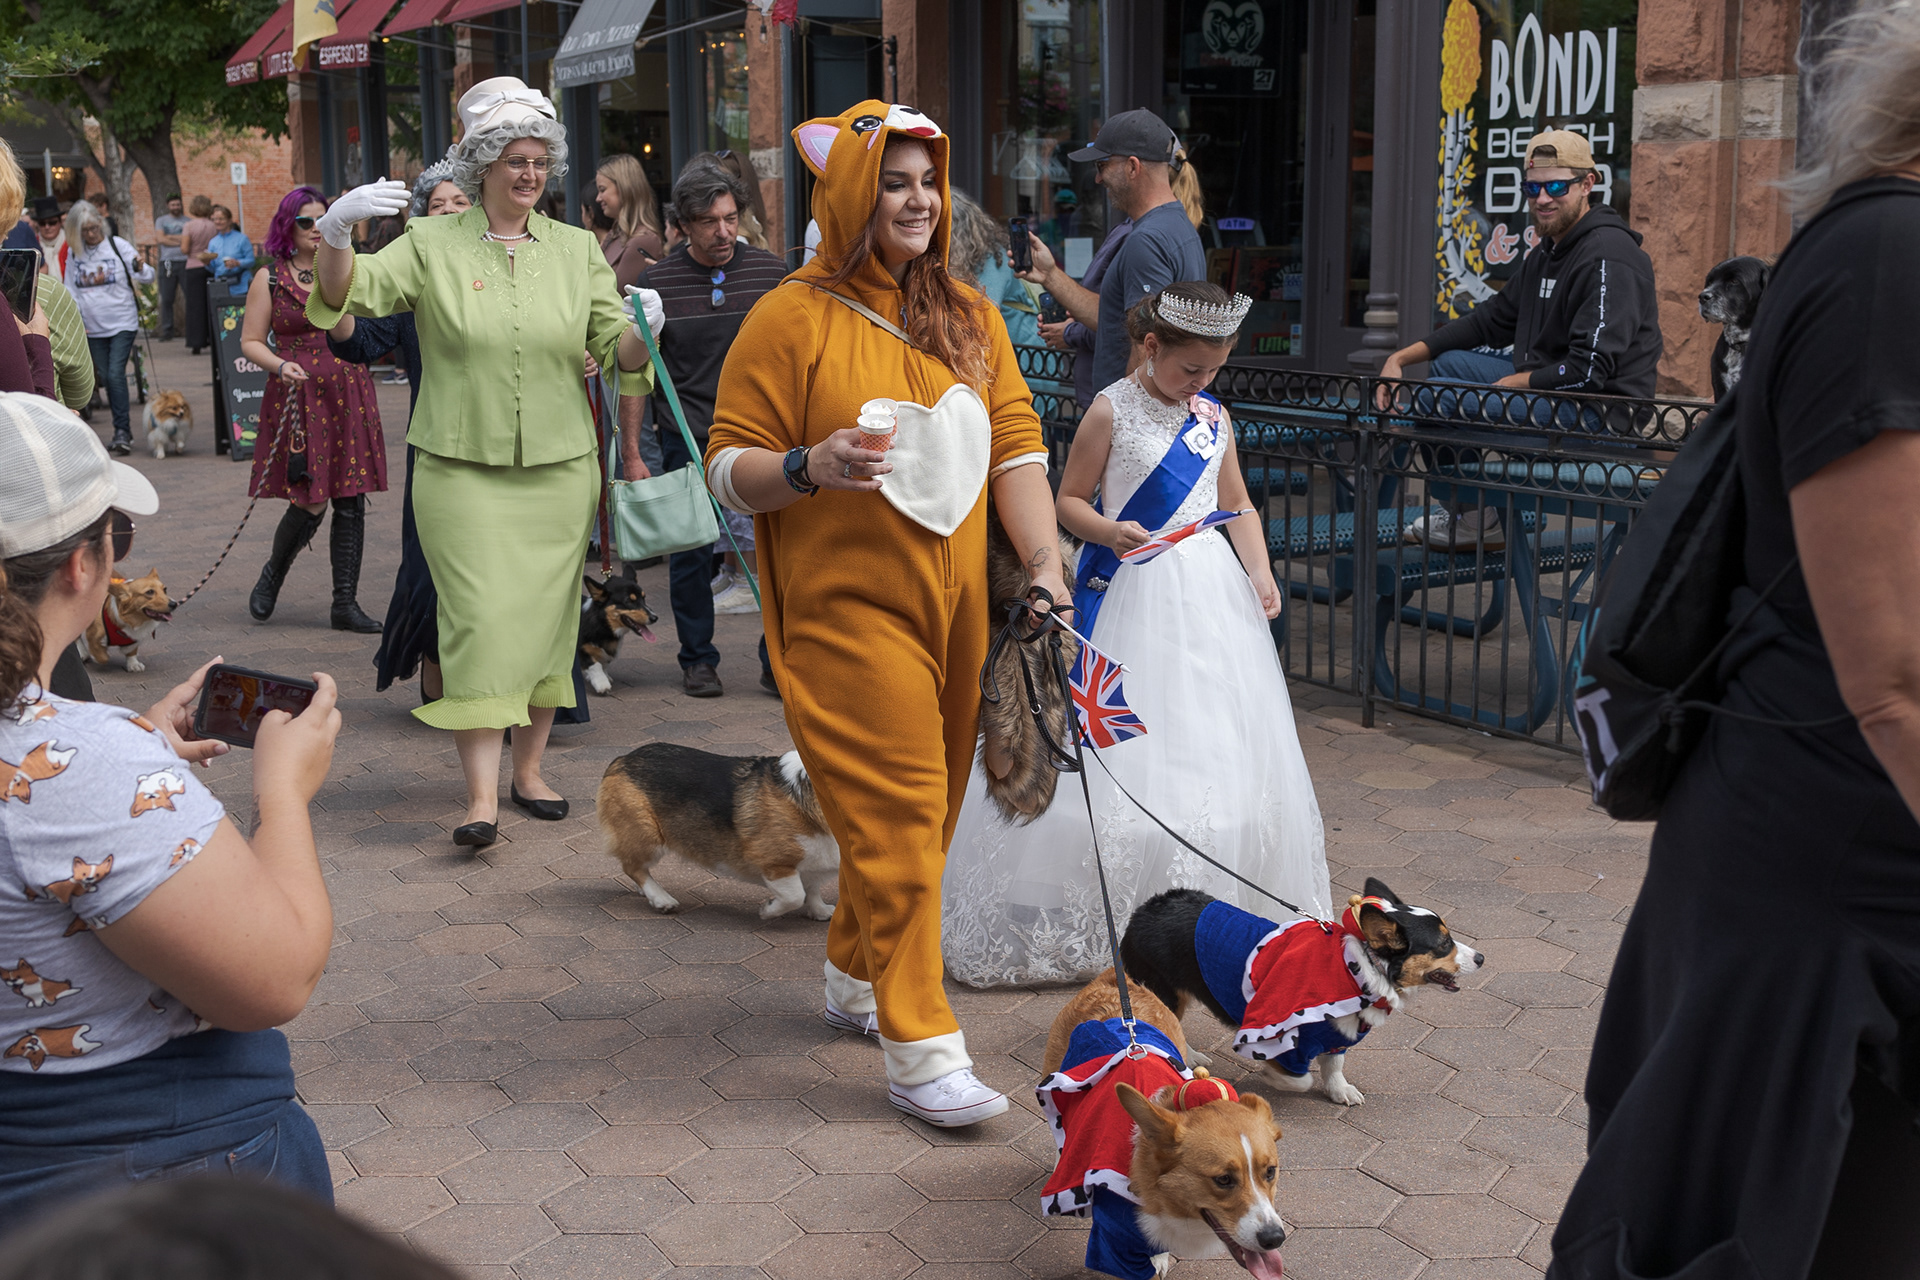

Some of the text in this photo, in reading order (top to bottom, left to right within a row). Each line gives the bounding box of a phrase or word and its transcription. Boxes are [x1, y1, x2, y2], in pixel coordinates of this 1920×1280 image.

[1489, 12, 1617, 120] BONDI
[1487, 122, 1614, 158] BEH
[1485, 164, 1612, 213] BR
[1225, 220, 1246, 228] ATM
[1485, 223, 1520, 265] &
